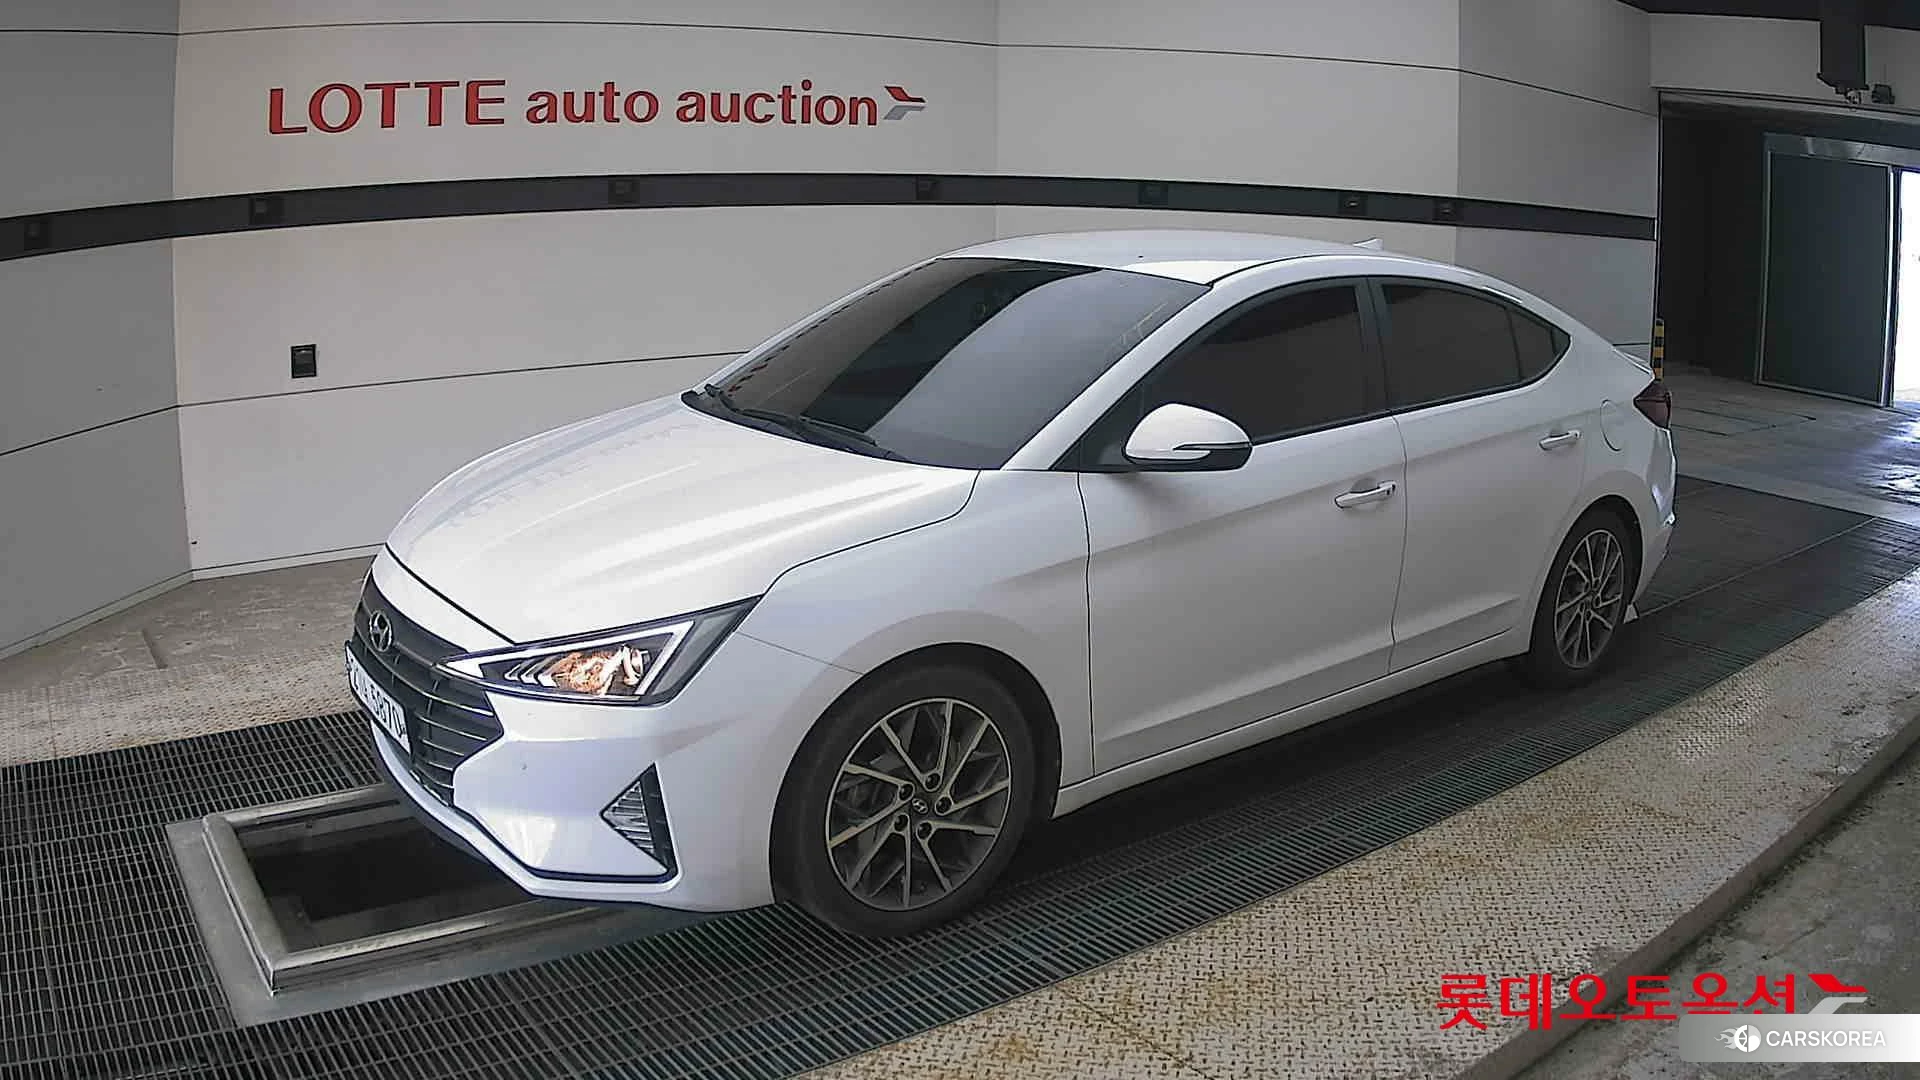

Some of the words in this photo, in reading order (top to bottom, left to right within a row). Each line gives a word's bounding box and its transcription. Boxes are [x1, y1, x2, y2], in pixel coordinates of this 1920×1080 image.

[268, 79, 506, 135] LOTTE
[526, 81, 659, 124] auto
[676, 80, 878, 126] auction
